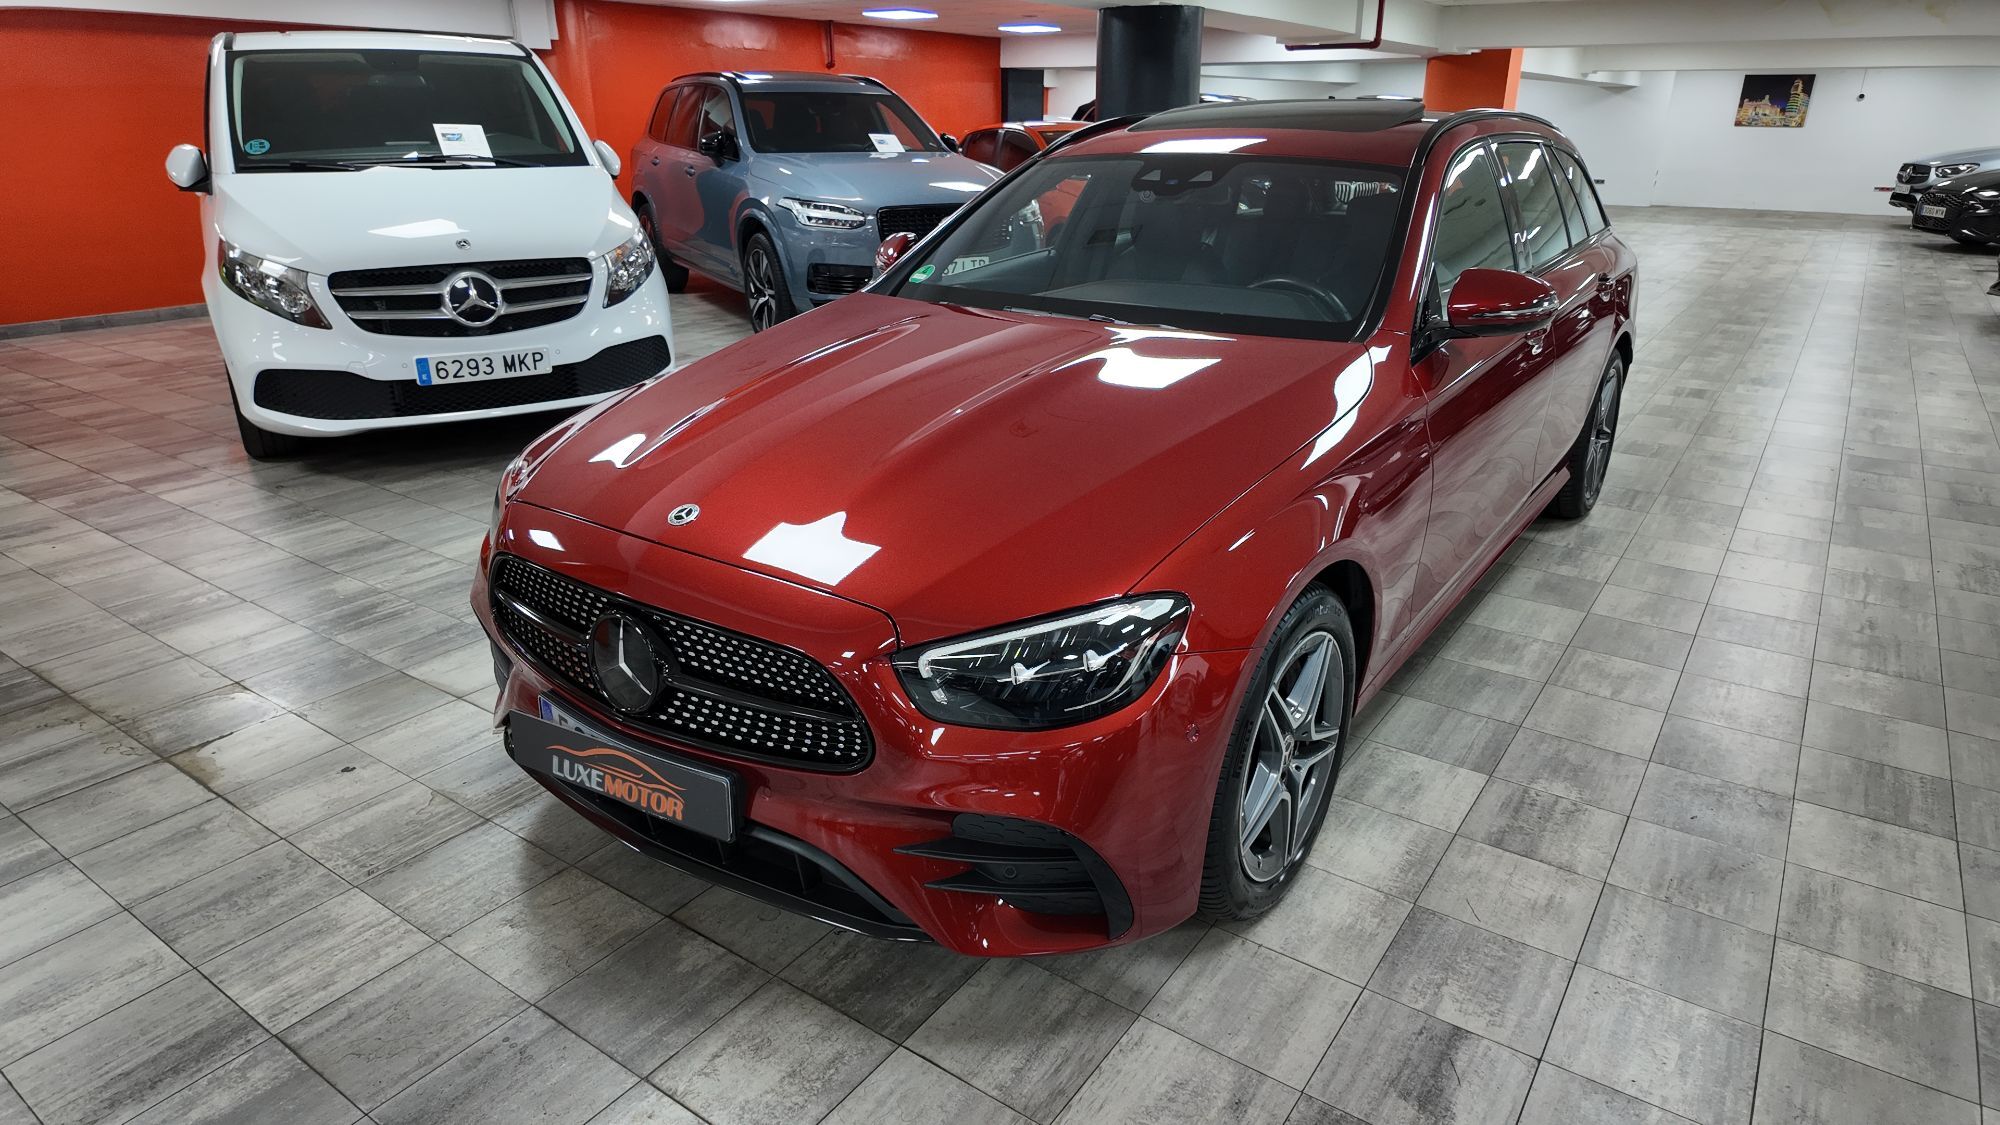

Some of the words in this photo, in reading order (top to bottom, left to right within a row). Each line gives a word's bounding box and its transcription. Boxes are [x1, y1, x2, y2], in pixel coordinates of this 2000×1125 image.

[435, 356, 495, 380] 6293
[502, 351, 544, 374] MKP
[552, 754, 684, 821] LUXEMOTOR
